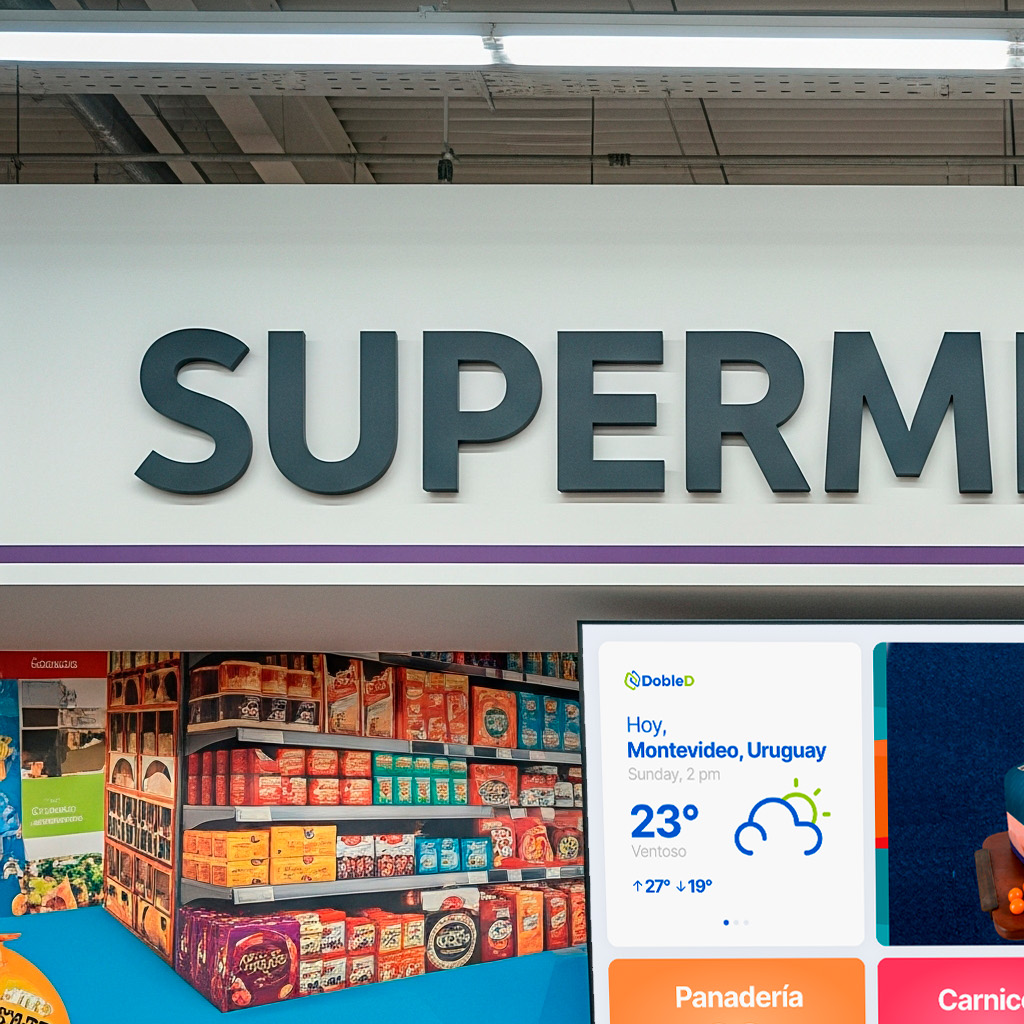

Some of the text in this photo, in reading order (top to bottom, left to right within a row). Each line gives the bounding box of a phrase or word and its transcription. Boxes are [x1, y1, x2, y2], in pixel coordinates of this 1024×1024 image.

[641, 674, 695, 687] DobleD
[627, 716, 667, 737] Hoy,
[627, 741, 828, 763] Montevideo, Uruguay
[628, 767, 721, 784] Sunday, 2 pm
[631, 804, 699, 839] 23°
[631, 845, 687, 858] Ventoso
[675, 983, 804, 1009] Panadería
